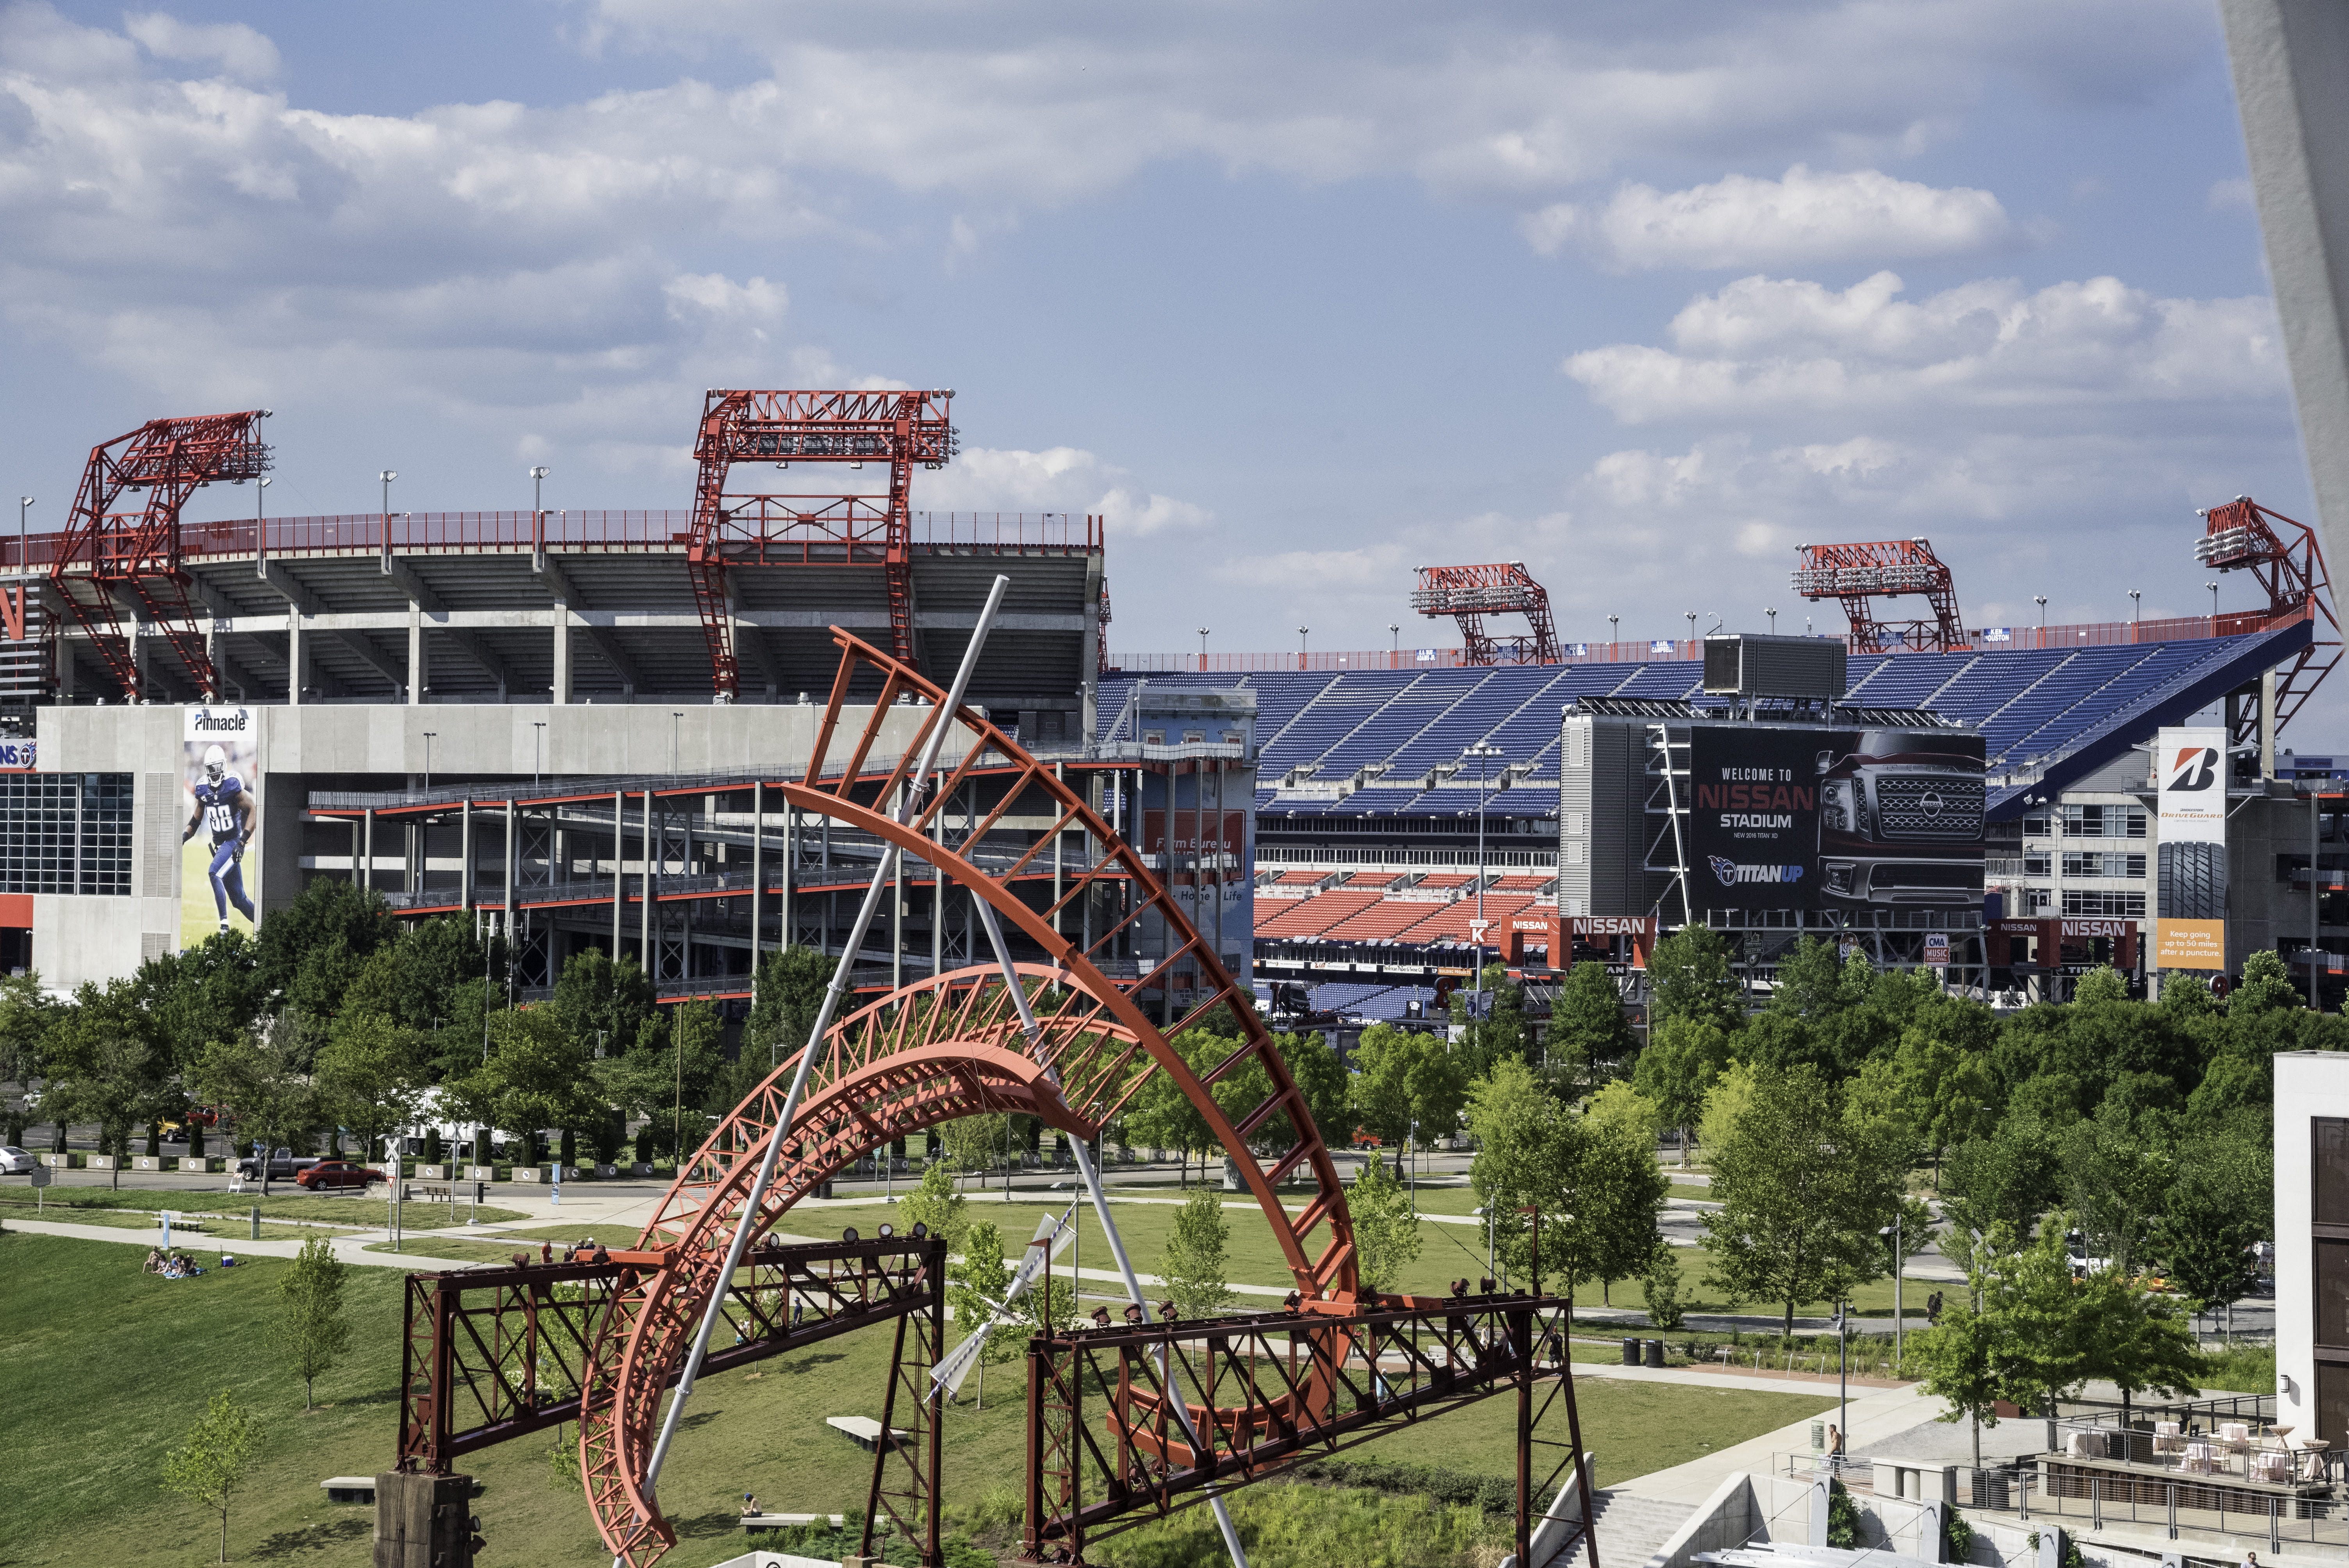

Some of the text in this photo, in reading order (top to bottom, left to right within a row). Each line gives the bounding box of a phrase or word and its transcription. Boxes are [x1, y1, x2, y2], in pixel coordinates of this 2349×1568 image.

[195, 714, 245, 731] Pinnacle
[1722, 768, 1791, 781] WELCOME TO
[1698, 784, 1813, 810] NISSAN
[206, 804, 234, 832] 98
[1720, 814, 1791, 828] STADIUM
[1223, 891, 1242, 901] Life
[1513, 921, 1547, 930] NISSAN
[1574, 919, 1645, 934] NISSAN
[2001, 923, 2037, 932] NISSAN
[2062, 921, 2125, 936] NISSAN
[1472, 928, 1485, 942] K
[2190, 931, 2210, 939] going
[1929, 938, 1945, 947] CMA
